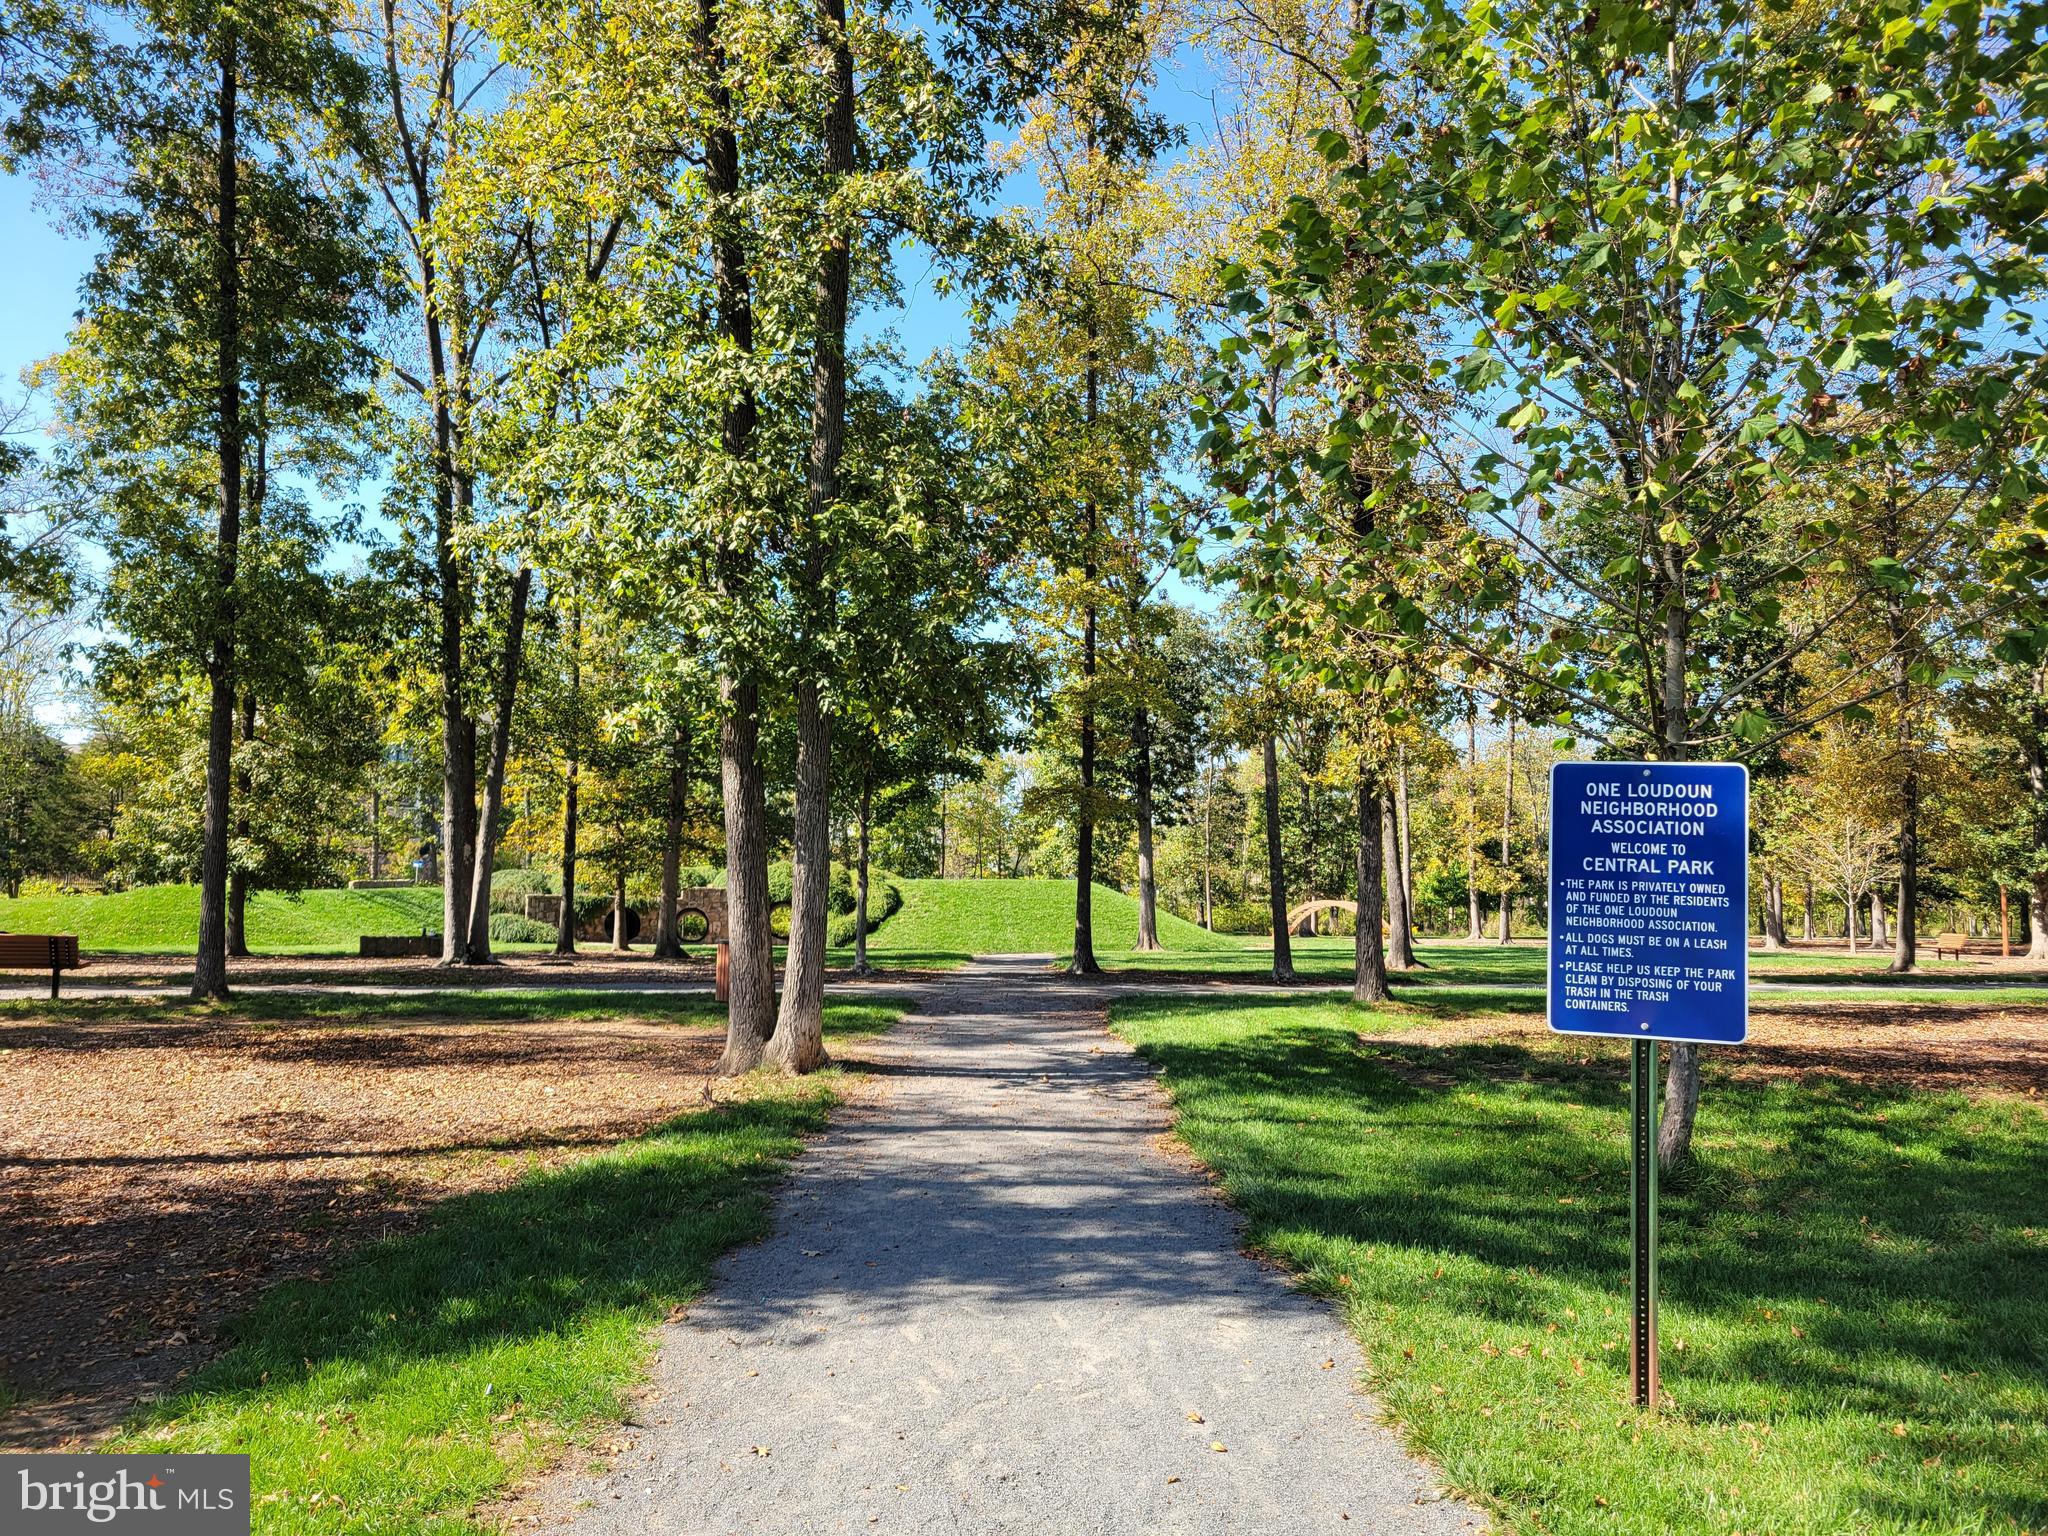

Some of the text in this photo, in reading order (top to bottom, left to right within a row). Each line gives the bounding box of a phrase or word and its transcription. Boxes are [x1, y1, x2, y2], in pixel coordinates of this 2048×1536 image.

[1587, 783, 1712, 798] ONE LOUDOUN
[1581, 801, 1717, 817] NEIGHBORHOOD
[1591, 820, 1704, 835] ASSOCIATION
[1611, 842, 1685, 855] WELCOME TO
[1583, 857, 1714, 875] CENTRAL PARK
[1566, 879, 1725, 894] THE PARK IS PRIVATELY OWNED
[1566, 892, 1729, 907] AND FUNDED BY THE RESIDENTS
[1566, 904, 1677, 917] OF THE ONE LOUDOUN
[1566, 916, 1717, 932] NEIGHBORHOOD ASSOCIATION.
[1566, 933, 1727, 949] ALL DOGS MUST BE ON A LEASH
[1565, 945, 1634, 957] AT ALL TIMES.
[1566, 961, 1735, 980] PLEASE HELP US KEEP THE PARK
[1566, 974, 1722, 992] CLEAN BY DISPOSING OF YOUR
[1565, 986, 1668, 1001] TRASH IN THE TRASH
[1565, 999, 1629, 1012] CONTAINERS.
